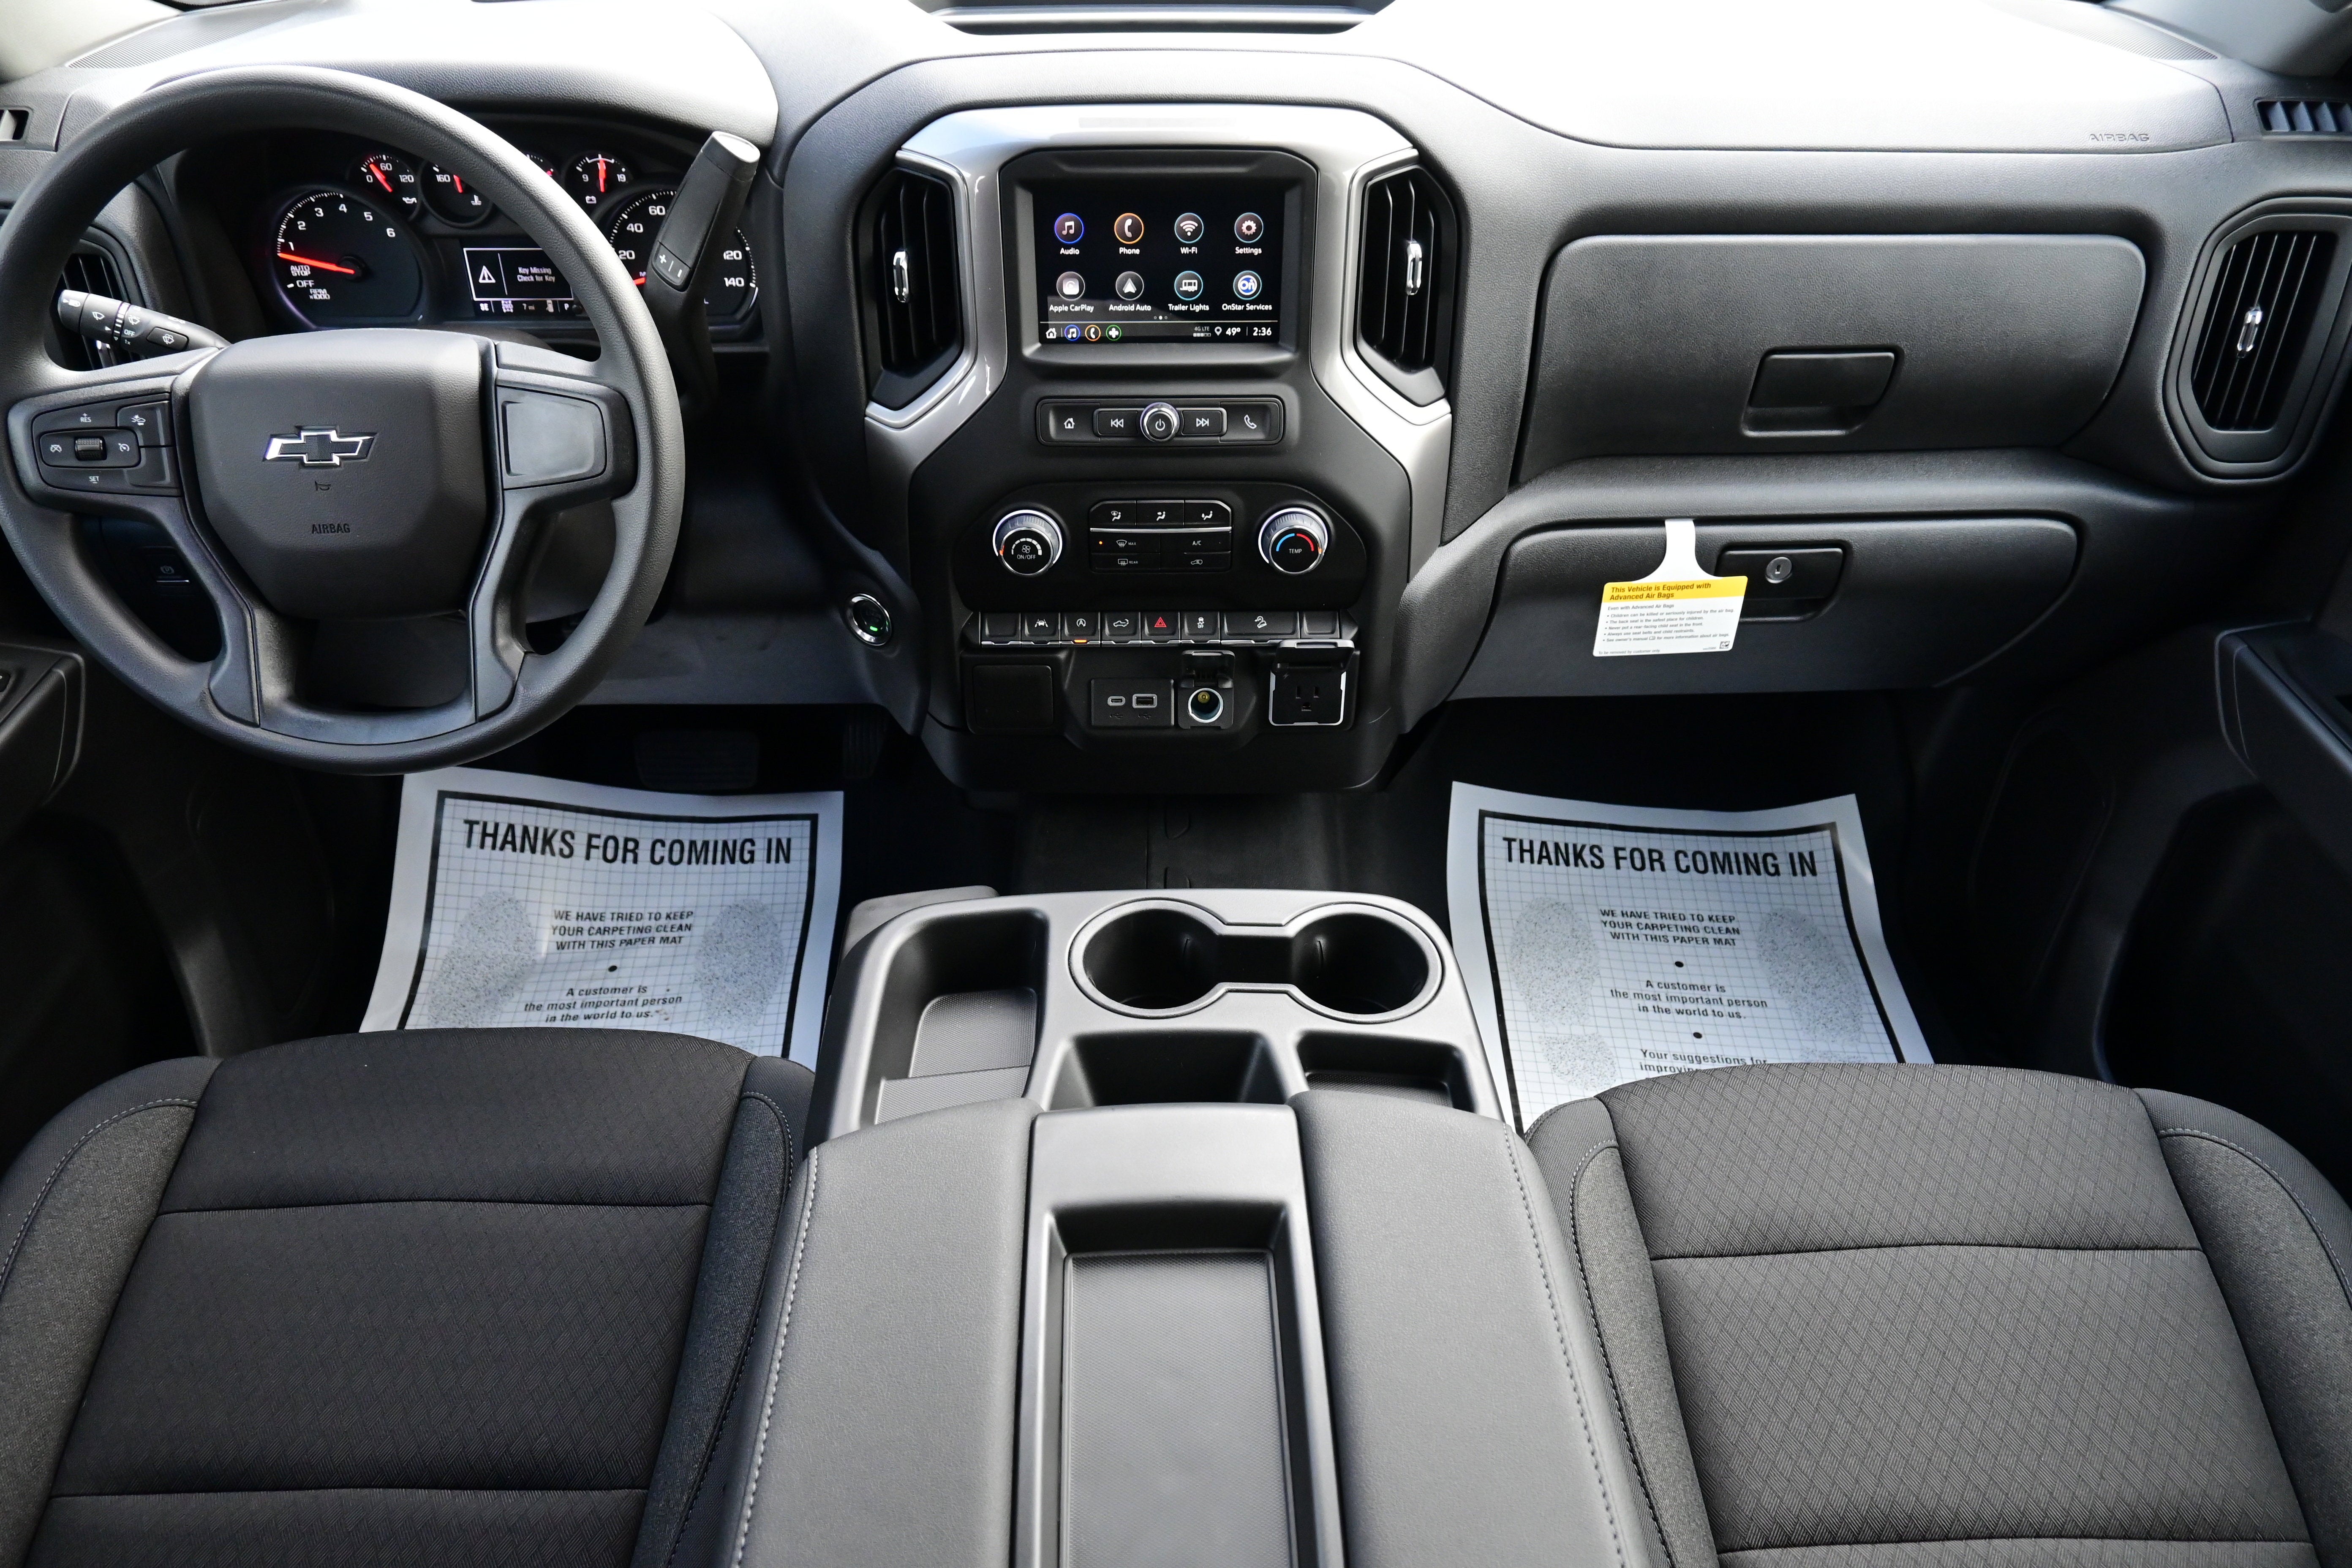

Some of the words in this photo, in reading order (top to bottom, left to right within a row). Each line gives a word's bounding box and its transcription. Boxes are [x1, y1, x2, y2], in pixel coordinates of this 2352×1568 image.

[399, 174, 414, 182] 120
[436, 174, 451, 182] 160
[582, 174, 589, 182] 9
[617, 174, 626, 182] 19
[314, 208, 324, 217] 3
[339, 204, 347, 213] 4
[649, 206, 666, 215] 60
[364, 212, 373, 221] 5
[297, 221, 306, 230] 2
[626, 223, 643, 233] 40
[386, 228, 396, 237] 6
[289, 242, 294, 251] 1
[1235, 247, 1262, 256] Settings
[618, 250, 635, 260] 20
[723, 250, 742, 260] 120
[518, 267, 529, 275] Key
[530, 267, 552, 275] Missing
[296, 280, 314, 288] OFF
[724, 278, 745, 287] 140
[1049, 305, 1068, 313] Apple
[1070, 305, 1094, 313] CarPlay
[1190, 304, 1209, 312] Lights
[1252, 327, 1272, 336] 2:36
[312, 523, 350, 534] AIRBAG
[1663, 583, 1694, 591] Equipped
[463, 819, 575, 859] THANKS
[585, 833, 639, 864] FOR
[650, 838, 755, 865] COMING
[766, 837, 791, 864] IN
[1503, 837, 1605, 869] THANKS
[1614, 847, 1666, 872] FOR
[1674, 850, 1781, 877] COMING
[1789, 850, 1817, 877] IN
[553, 910, 571, 920] WE
[575, 912, 606, 921] HAVE
[611, 912, 643, 921] TRIED
[648, 912, 661, 921] TO
[665, 911, 694, 920] KEEP
[1600, 909, 1617, 917] WE
[1621, 910, 1650, 919] HAVE
[1653, 912, 1686, 921] TRIED
[1690, 913, 1704, 922] TO
[1708, 915, 1735, 923] KEEP
[551, 926, 583, 936] YOUR
[588, 925, 652, 936] CARPETING
[656, 923, 692, 932] CLEAN
[1601, 920, 1633, 929] YOUR
[1637, 922, 1700, 934] CARPETING
[1704, 926, 1740, 935] CLEAN
[555, 941, 585, 950] WITH
[591, 939, 615, 949] THIS
[619, 936, 655, 947] PAPER
[659, 936, 683, 945] MAT
[1610, 931, 1640, 941] WITH
[1643, 934, 1669, 943] THIS
[1673, 936, 1709, 945] PAPER
[1713, 938, 1736, 946] MAT
[566, 988, 574, 996] A
[578, 987, 634, 996] customer
[637, 985, 647, 994] is
[1646, 980, 1653, 988] A
[1657, 981, 1711, 992] customer
[1716, 984, 1726, 993] is
[1610, 989, 1628, 999] the
[1633, 992, 1662, 1001] most
[1666, 994, 1723, 1005] important
[1727, 999, 1767, 1007] person
[524, 1002, 542, 1011] the
[547, 1001, 577, 1010] most
[580, 998, 638, 1010] important
[642, 996, 682, 1007] person
[1638, 1004, 1649, 1012] in
[1653, 1005, 1671, 1014] the
[1675, 1008, 1709, 1017] world
[1712, 1010, 1724, 1018] to
[545, 1014, 556, 1023] in
[561, 1013, 579, 1021] the
[583, 1011, 616, 1021] world
[1640, 1049, 1668, 1059] Your
[1673, 1052, 1746, 1065] suggestions
[1640, 1062, 1699, 1073] improvin
